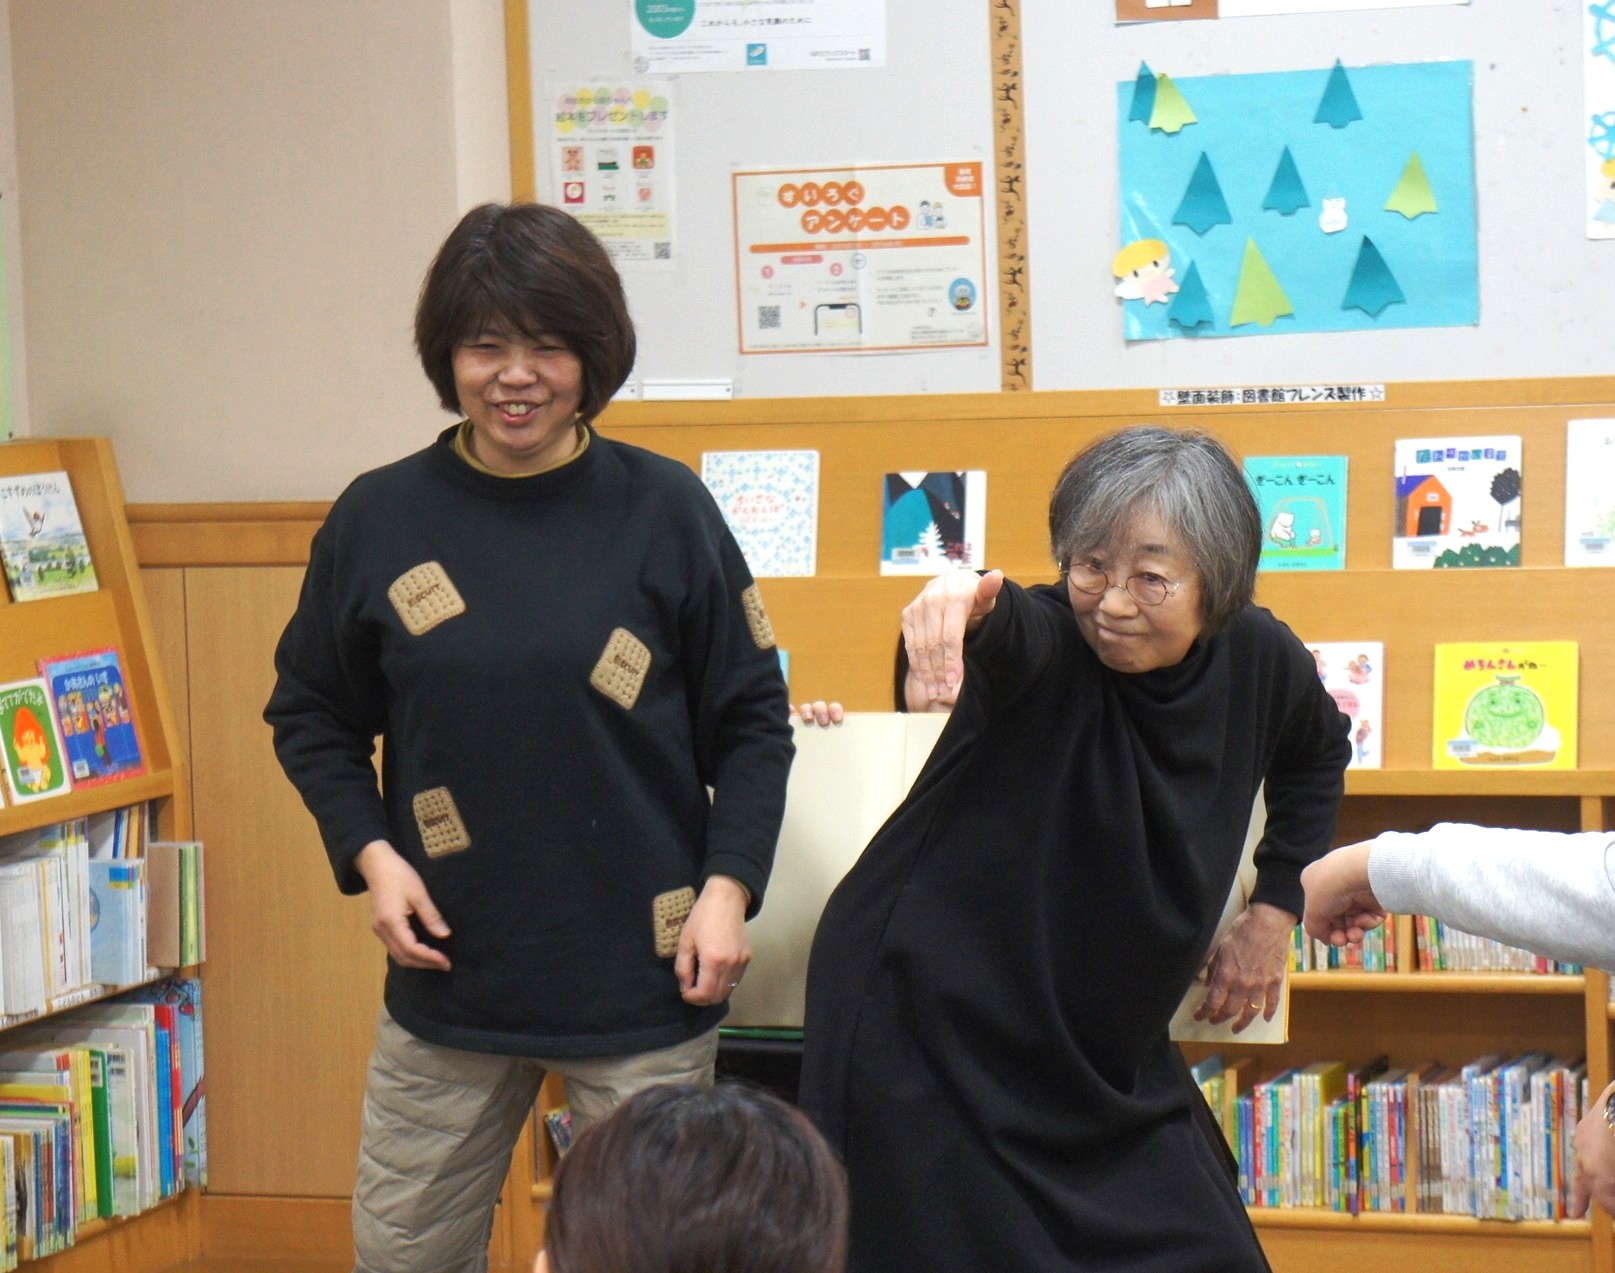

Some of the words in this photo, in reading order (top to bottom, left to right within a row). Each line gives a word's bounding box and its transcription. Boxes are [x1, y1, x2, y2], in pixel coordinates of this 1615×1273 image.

[803, 211, 908, 232] アンケート
[407, 583, 440, 609] BISCUIT
[613, 653, 640, 677] BISCUIT
